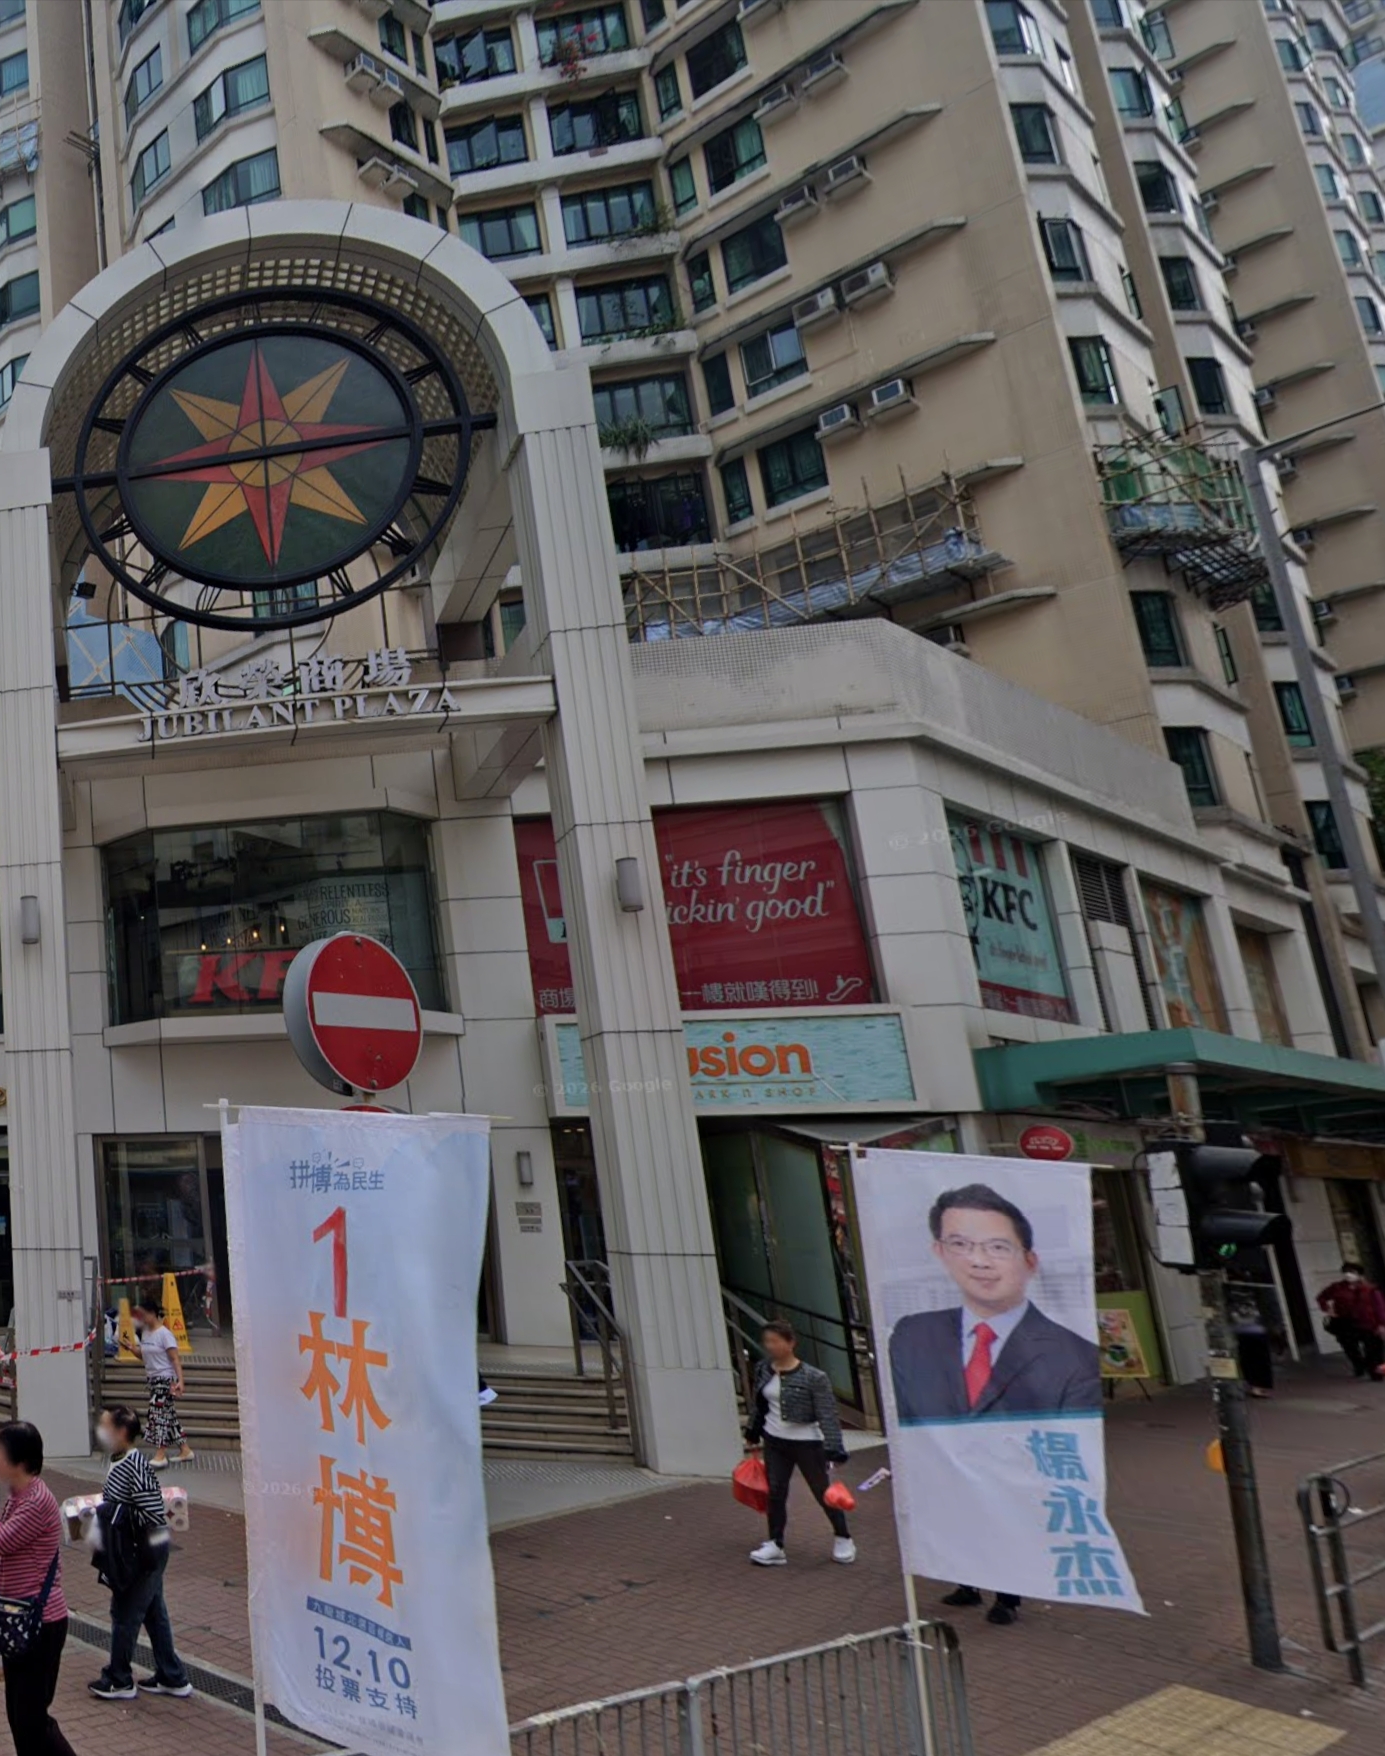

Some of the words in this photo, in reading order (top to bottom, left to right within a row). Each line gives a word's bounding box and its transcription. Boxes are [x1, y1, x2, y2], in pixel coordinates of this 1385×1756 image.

[180, 646, 412, 709] 欣榮商場
[136, 699, 320, 742] JUBILANT
[330, 687, 462, 720] PLAZA
[320, 883, 388, 900] RELENTLESS
[717, 849, 815, 894] finger
[666, 889, 740, 925] ickin'
[980, 876, 1038, 931] KFC
[188, 950, 299, 1004] KF
[687, 1031, 813, 1078] sion
[692, 1089, 729, 1099] ARK
[313, 1206, 348, 1318] 1
[1025, 1429, 1124, 1597] 楊永杰
[313, 1624, 412, 1690] 12.10
[315, 1663, 418, 1721] 投票支持
